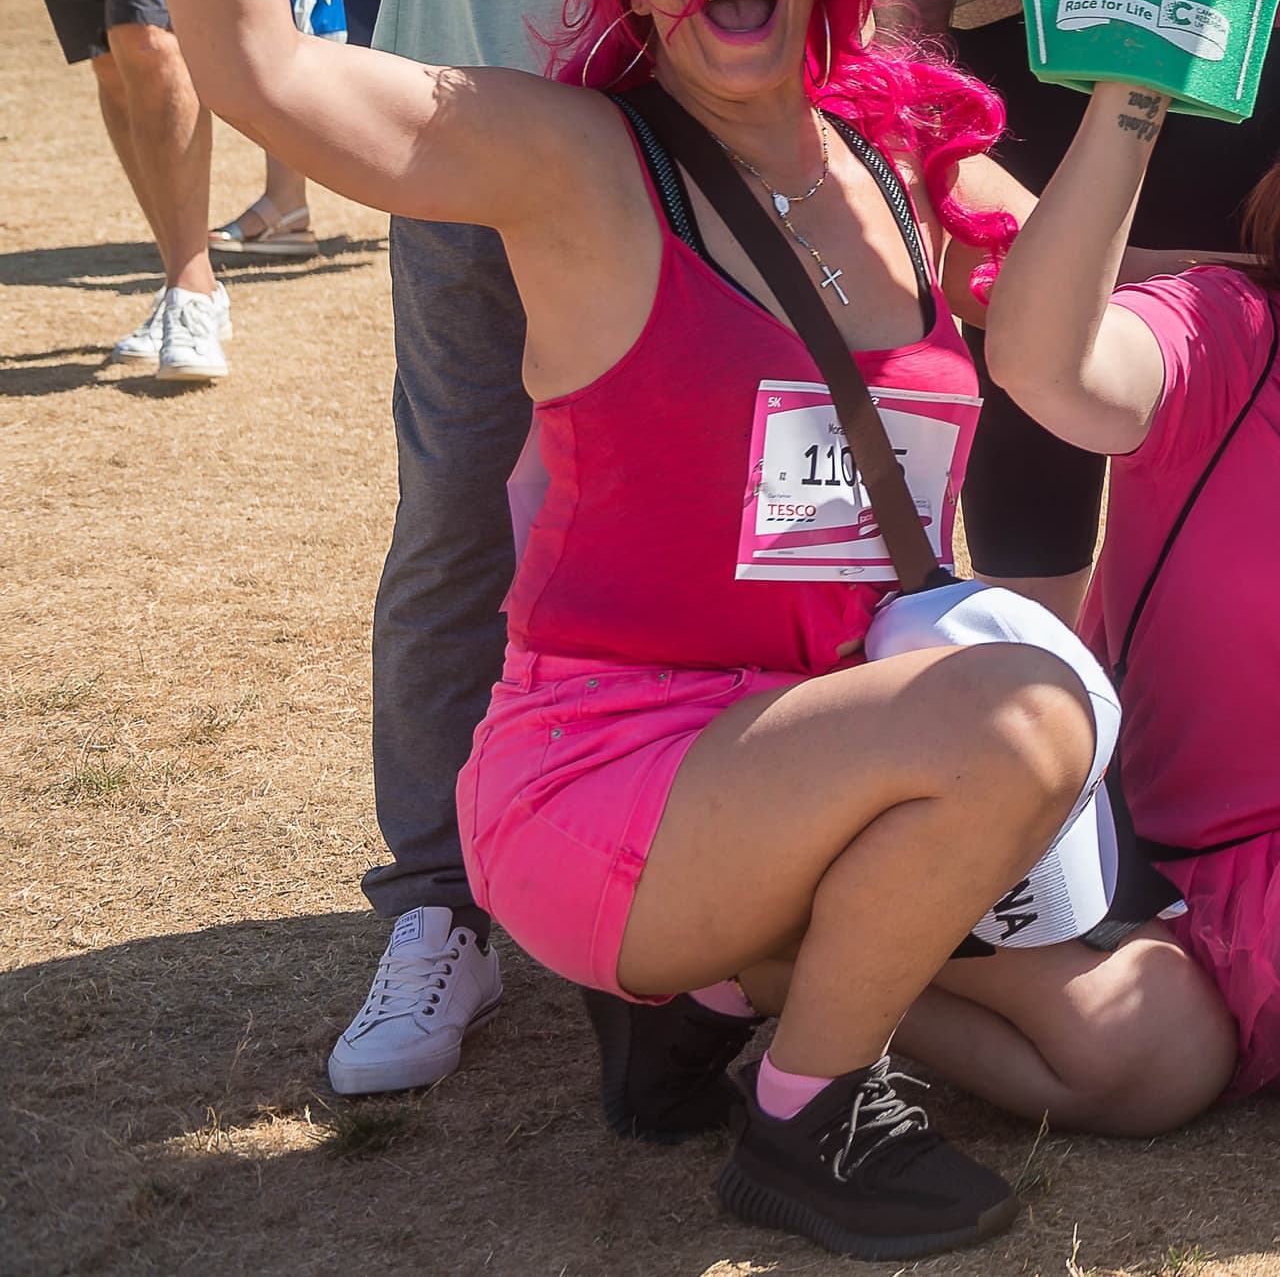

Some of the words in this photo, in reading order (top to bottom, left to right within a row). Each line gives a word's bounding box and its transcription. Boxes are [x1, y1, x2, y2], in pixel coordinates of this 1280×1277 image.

[1126, 1, 1153, 21] Life
[767, 396, 783, 408] 5K
[767, 504, 817, 517] TESCO
